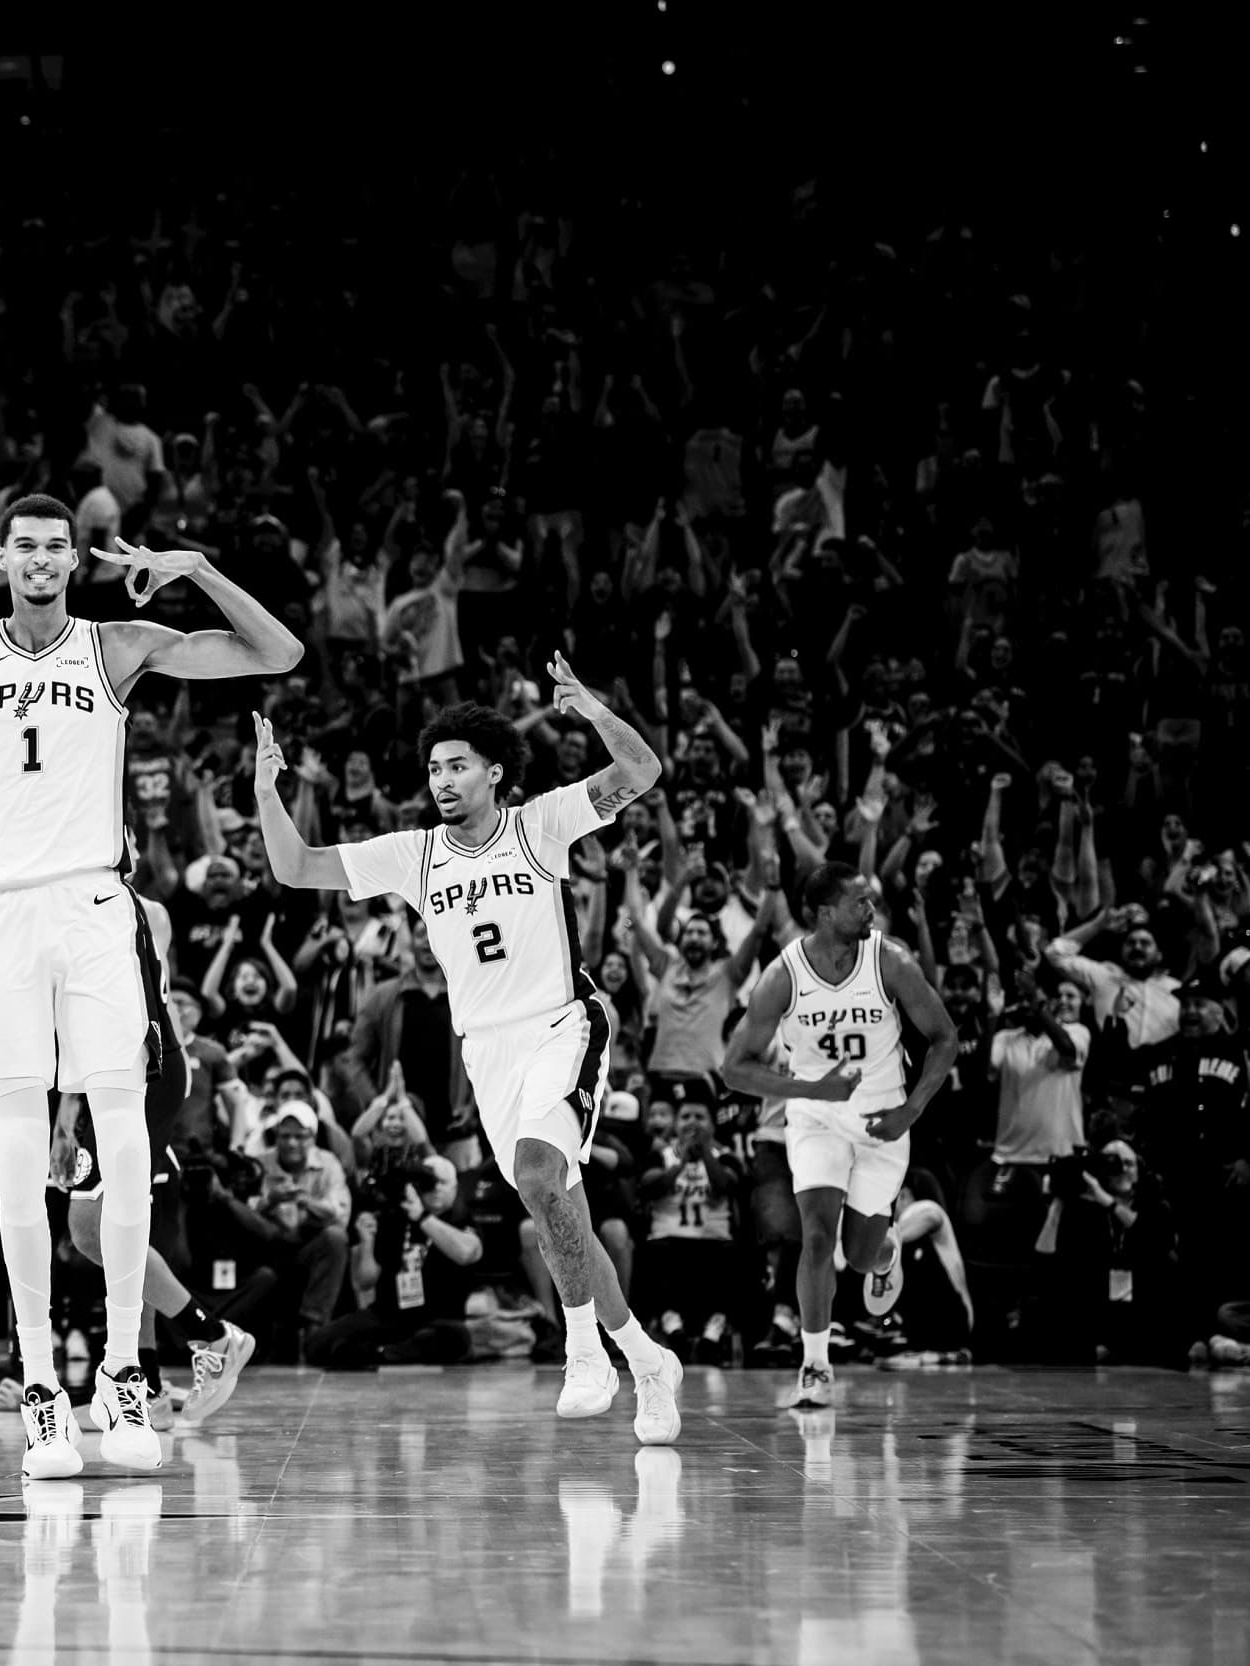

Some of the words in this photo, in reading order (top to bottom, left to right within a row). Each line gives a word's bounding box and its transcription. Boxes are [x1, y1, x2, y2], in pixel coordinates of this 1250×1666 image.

[21, 725, 44, 774] 1
[430, 872, 535, 916] SPURS
[471, 920, 509, 966] 2
[797, 1007, 883, 1031] SPURS
[817, 1033, 867, 1061] 40
[680, 1204, 703, 1227] 11
